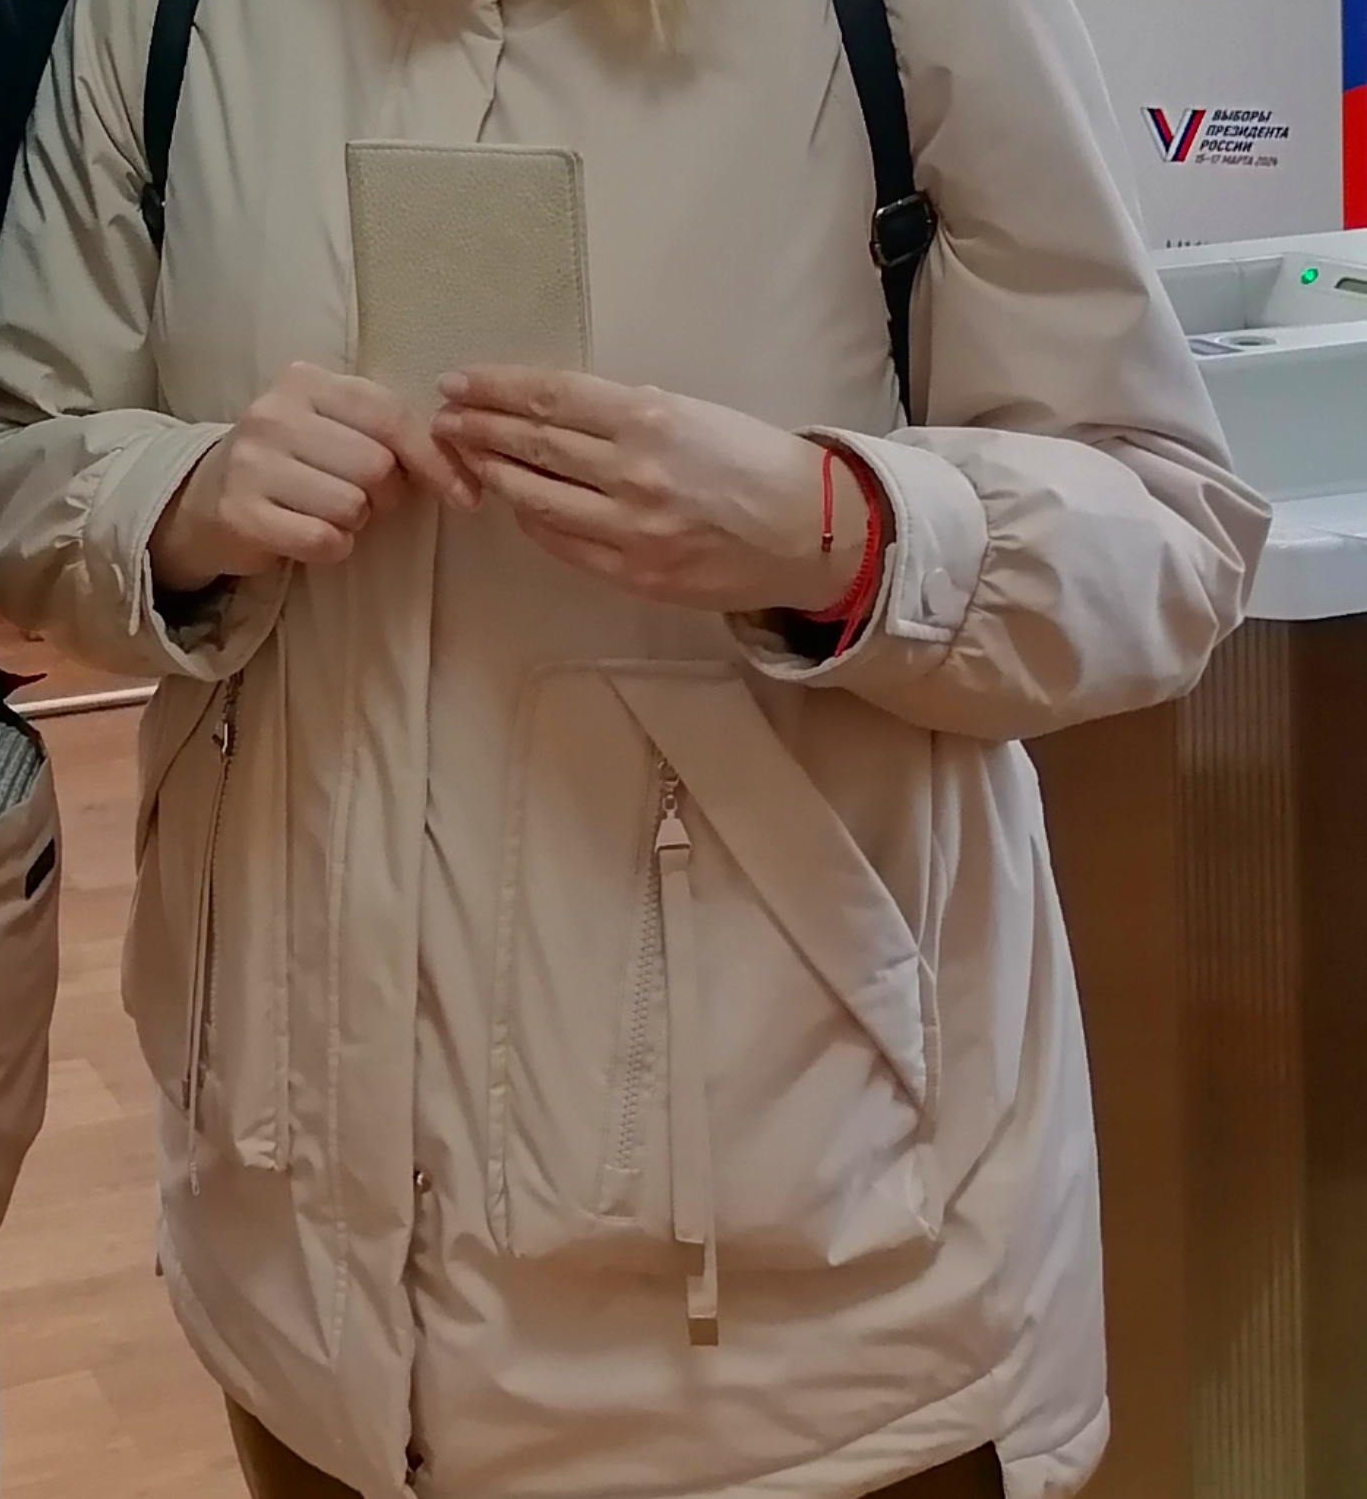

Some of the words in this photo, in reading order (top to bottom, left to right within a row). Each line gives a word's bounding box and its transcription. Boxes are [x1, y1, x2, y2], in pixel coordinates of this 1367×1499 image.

[1211, 109, 1273, 122] ВЫБОРЫ
[1205, 124, 1290, 139] ПРЕЗИДЕНТА
[1199, 139, 1254, 152] РОССИИ
